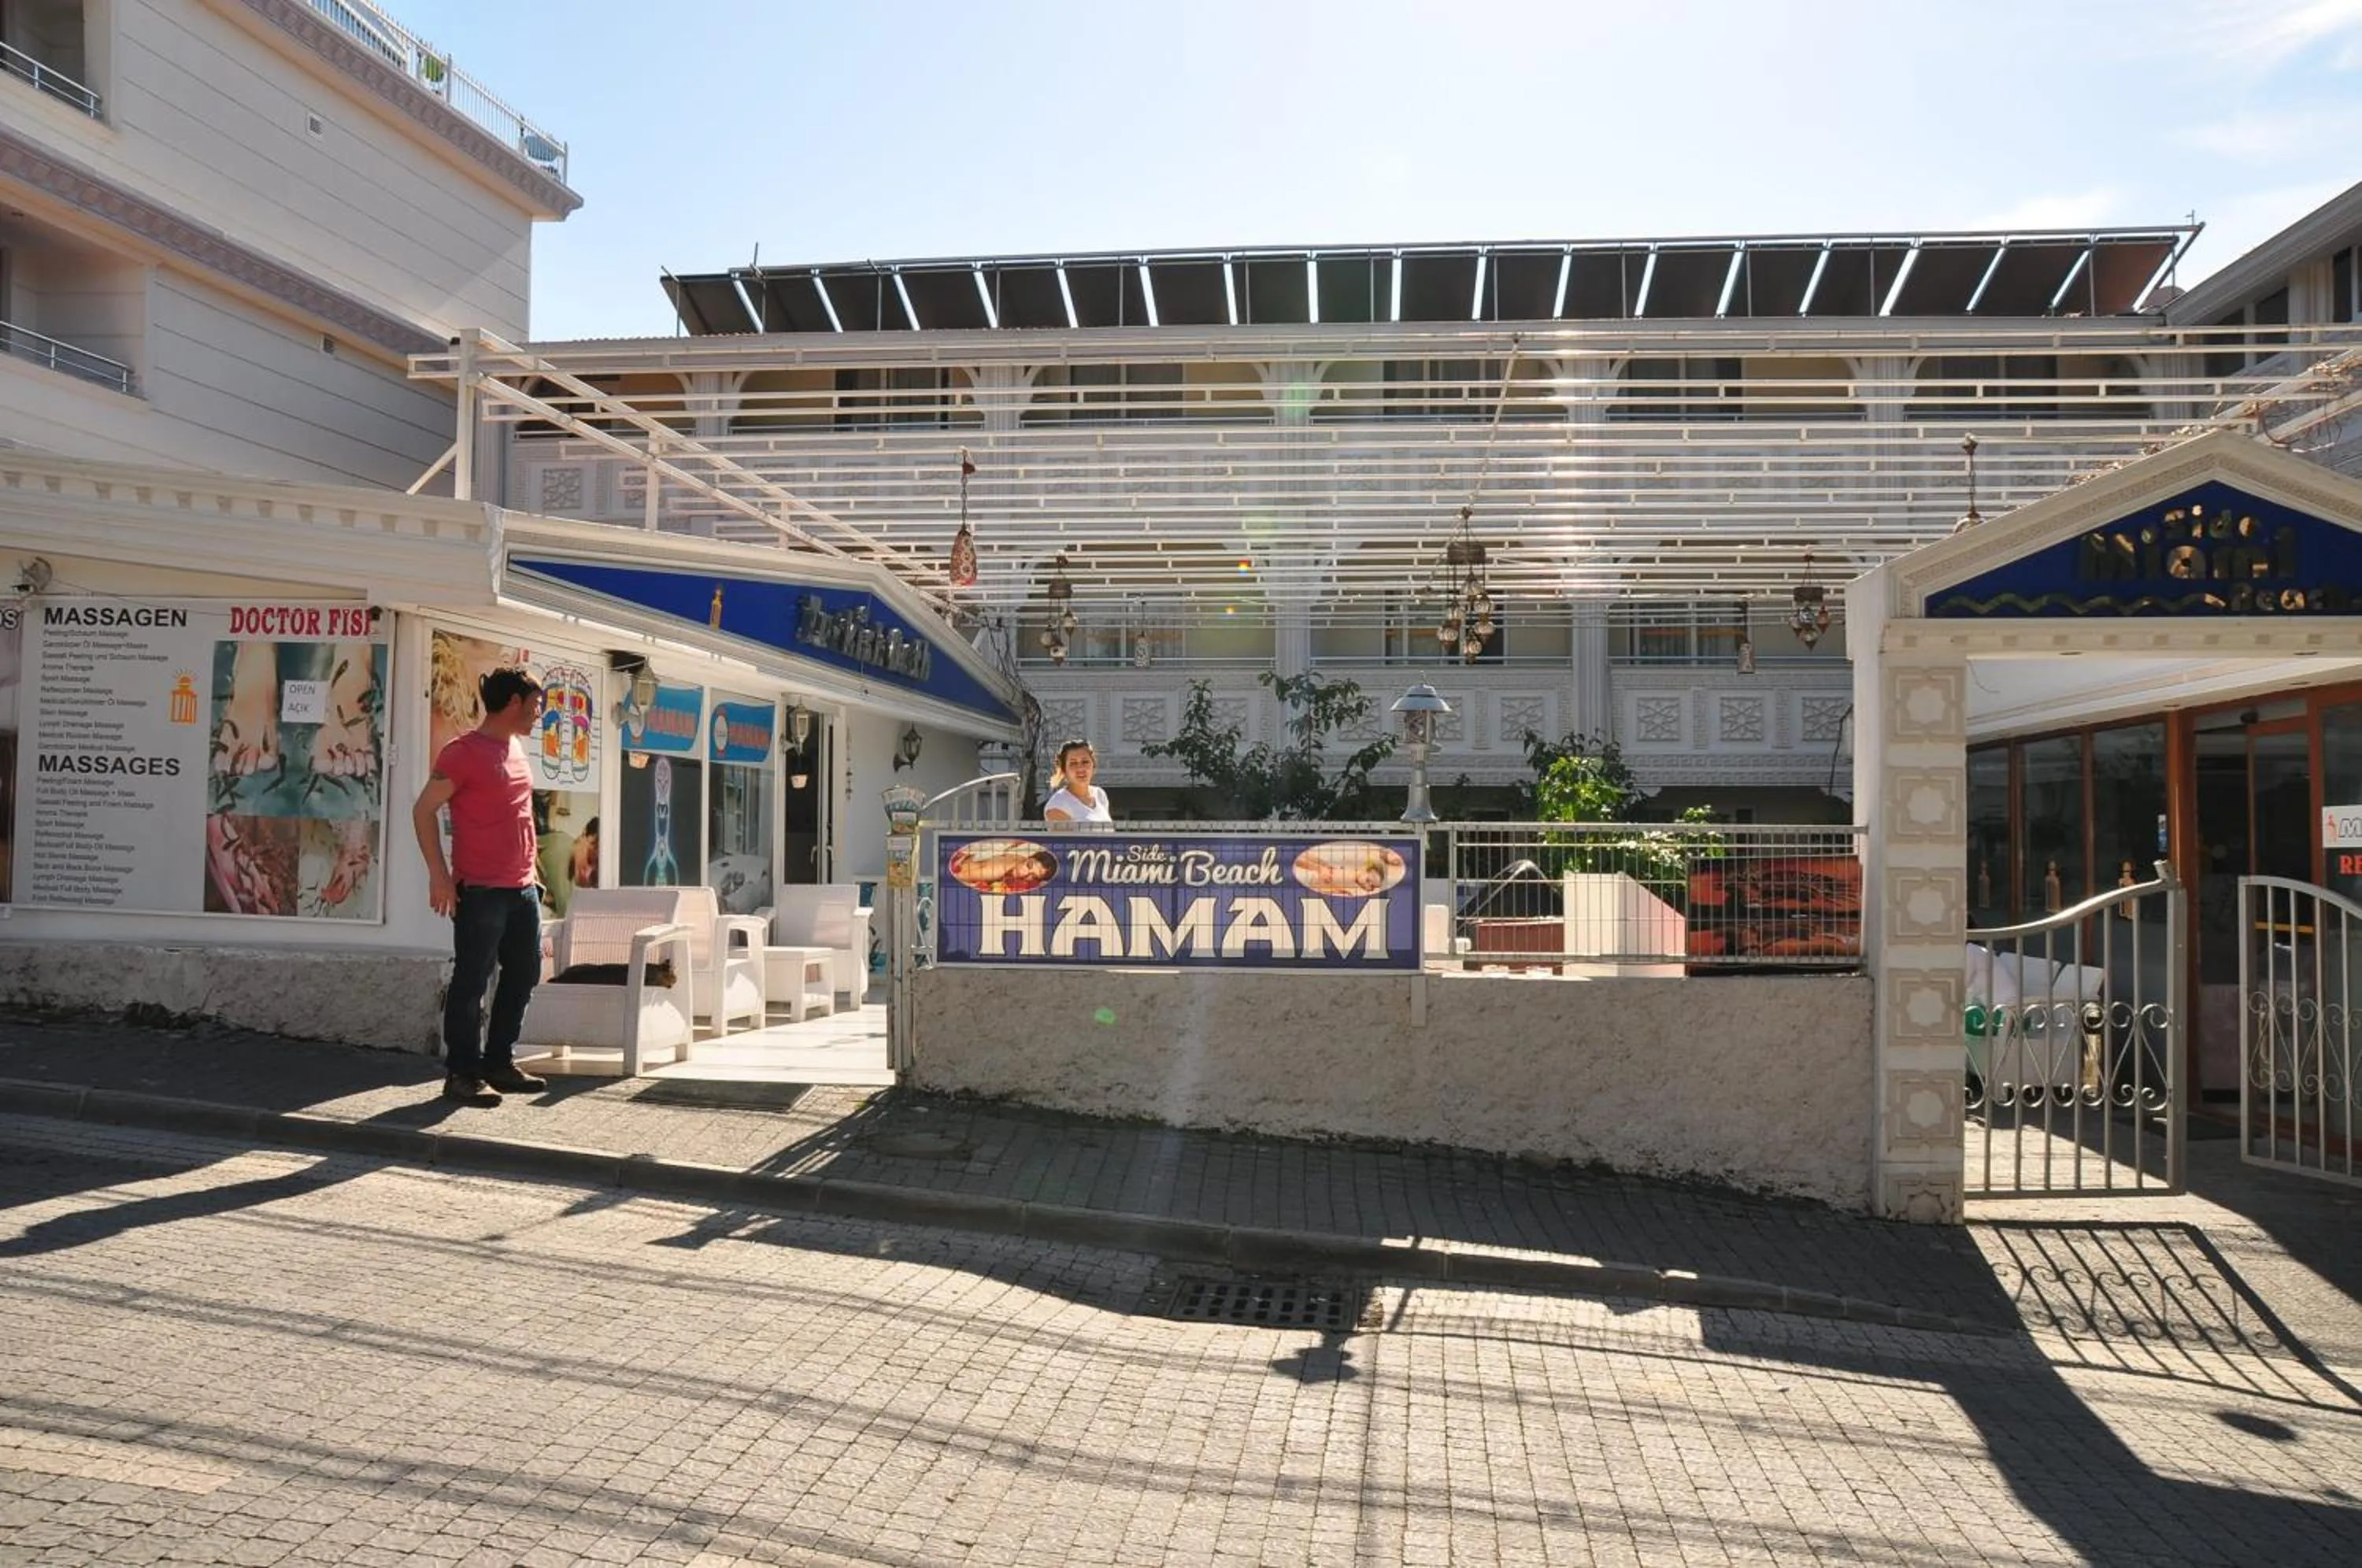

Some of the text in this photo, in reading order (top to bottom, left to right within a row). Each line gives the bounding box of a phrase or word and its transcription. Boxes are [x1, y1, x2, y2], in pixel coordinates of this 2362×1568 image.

[43, 607, 188, 627] MASSAGEN
[229, 606, 320, 635] DOCTOR
[61, 675, 91, 684] Massage
[289, 684, 316, 694] OPEN
[38, 754, 180, 776] MASSAGES
[1127, 843, 1167, 863] Side
[1067, 846, 1283, 887] Miami Beach
[976, 893, 1392, 960] HAMAM
